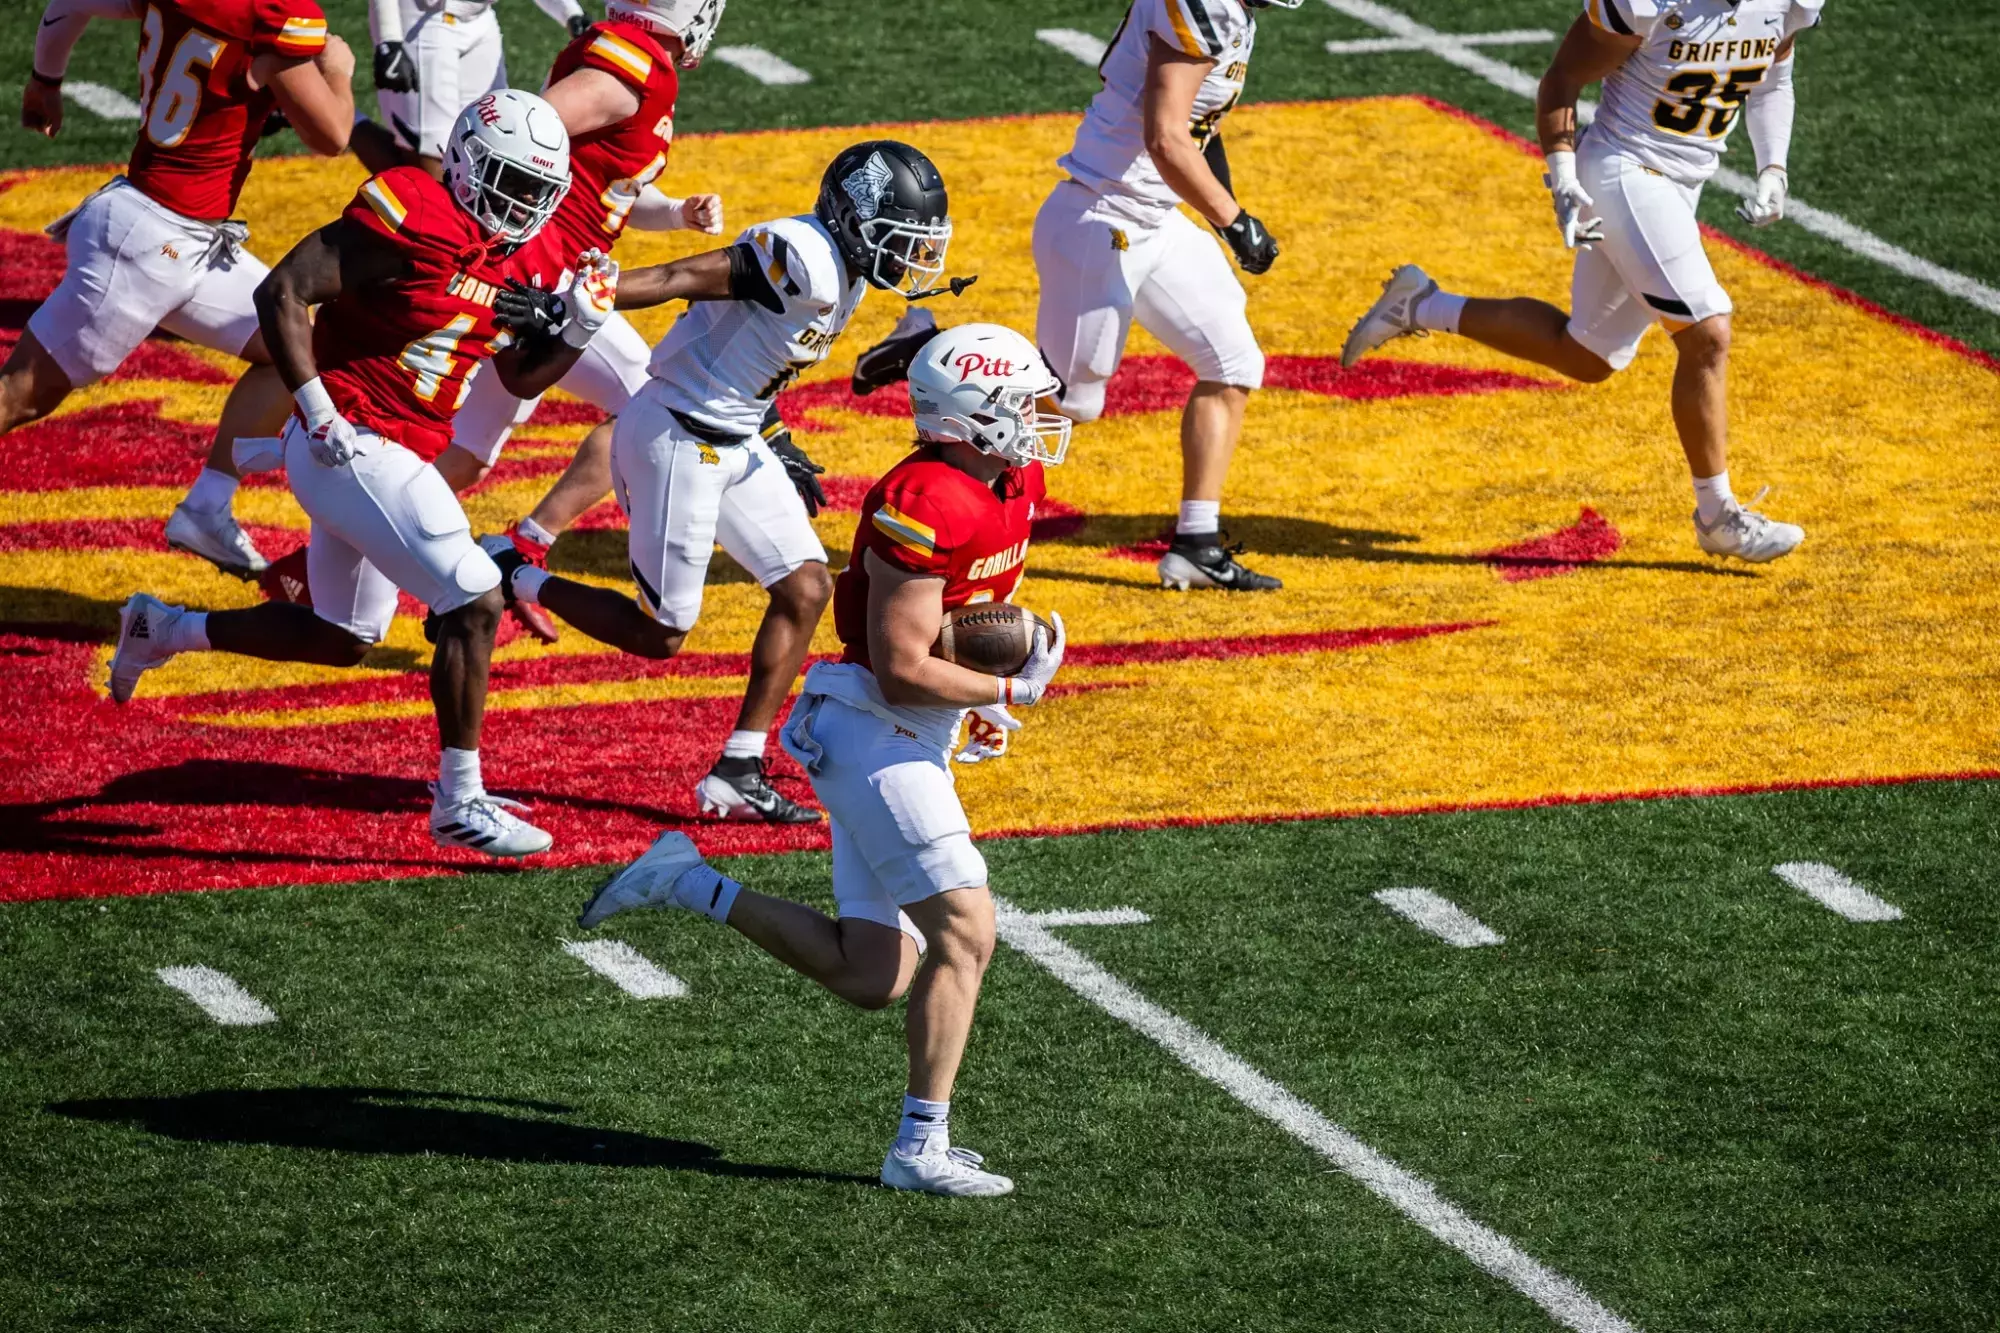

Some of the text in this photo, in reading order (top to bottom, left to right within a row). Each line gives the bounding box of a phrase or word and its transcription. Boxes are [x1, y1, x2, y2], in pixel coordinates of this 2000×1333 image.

[608, 7, 653, 30] Riddell
[1668, 37, 1776, 61] GRIFFONS
[471, 94, 501, 127] Pitt
[1651, 65, 1768, 139] 35
[532, 155, 555, 169] GRIT
[446, 271, 498, 308] GORI
[955, 353, 1015, 382] Pitt
